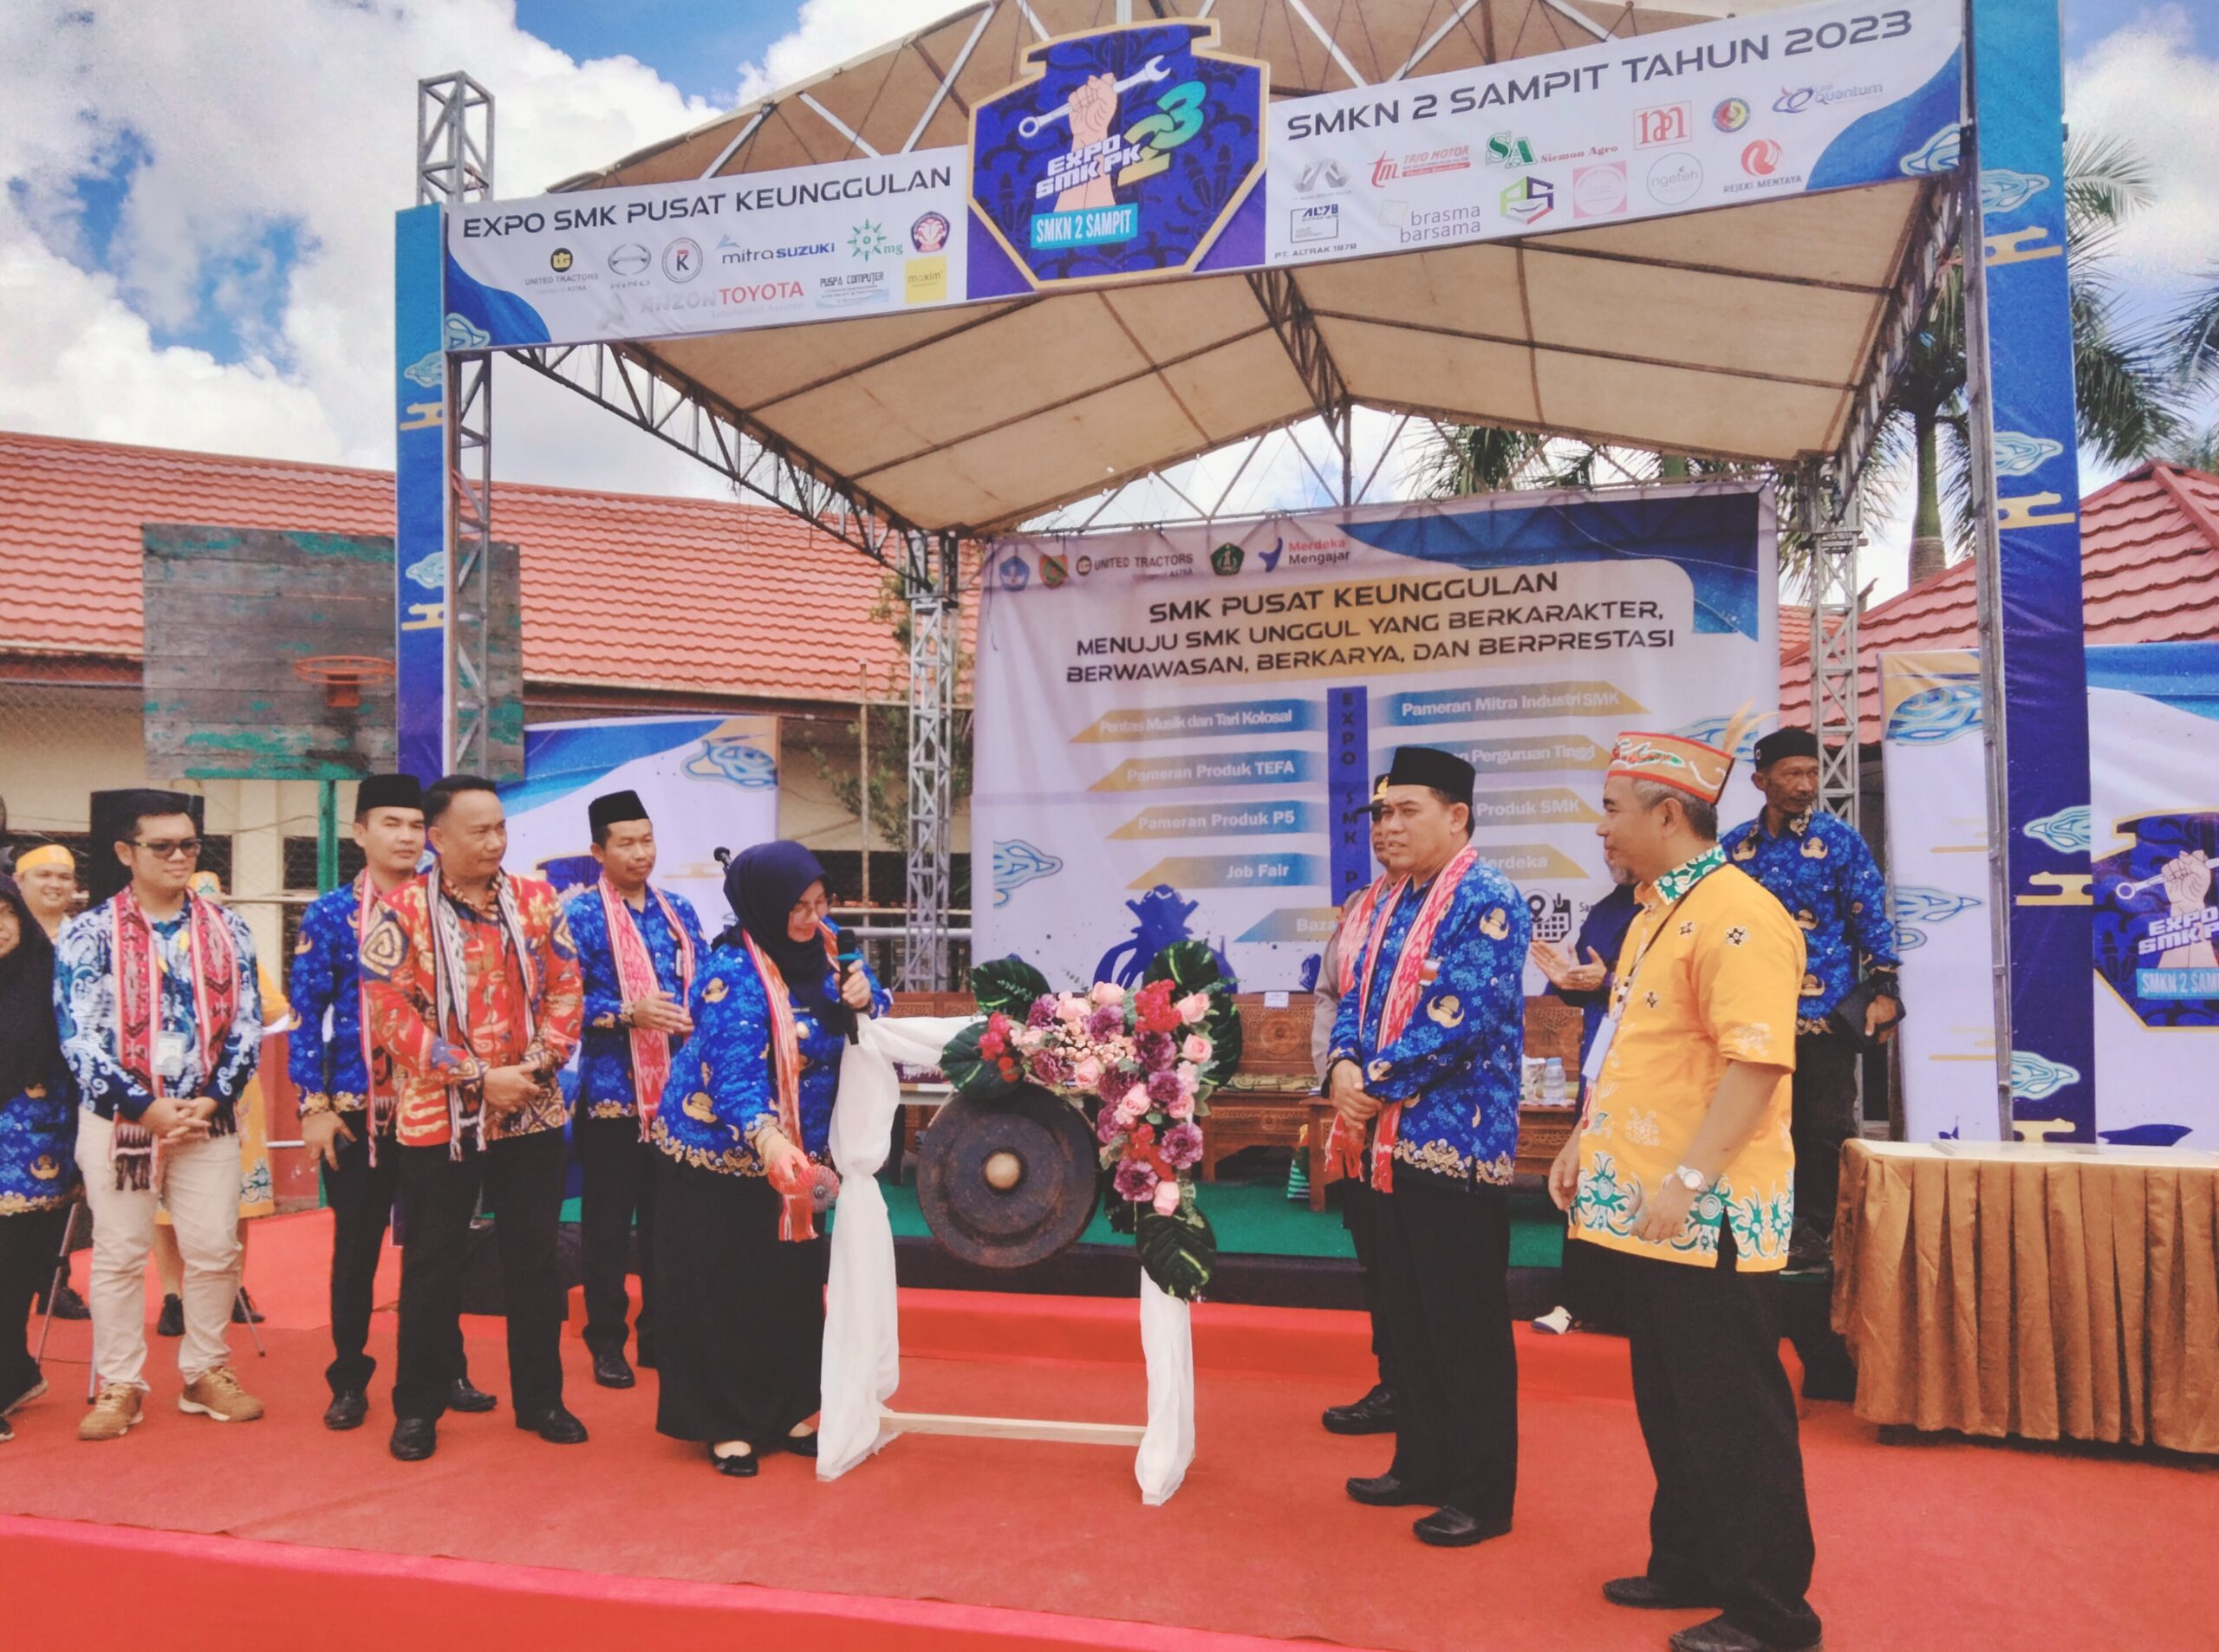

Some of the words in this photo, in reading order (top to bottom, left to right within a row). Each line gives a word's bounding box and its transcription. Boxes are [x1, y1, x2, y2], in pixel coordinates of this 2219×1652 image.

[1287, 100, 1400, 140] SMKN
[1412, 94, 1438, 120] 2
[1450, 62, 1610, 114] SAMPIT
[1621, 34, 1769, 83] TAHUN
[1784, 10, 1912, 56] 2023
[1815, 84, 1884, 105] Quantum
[1047, 133, 1121, 177] EXPO
[1403, 152, 1429, 164] TRIO
[1431, 145, 1470, 160] MOTOR
[1589, 146, 1618, 156] Agro
[1035, 160, 1100, 199] SMK
[1103, 143, 1142, 174] PK
[1723, 182, 1754, 194] REJEKI
[1756, 174, 1803, 189] MENTAYA
[463, 212, 545, 237] EXPO
[554, 205, 617, 231] SMK
[627, 193, 726, 224] PUSAT
[736, 166, 951, 212] KEUNGGULAN
[1036, 214, 1071, 244] SMKN
[1075, 214, 1083, 239] 2
[1085, 209, 1132, 237] SAMPIT
[1410, 205, 1480, 227] brasma
[1400, 220, 1480, 244] barsama
[1292, 245, 1331, 257] ALTRAK
[1333, 242, 1357, 251] 1978
[524, 276, 553, 287] UNITED
[556, 273, 599, 283] TRACTORS
[609, 280, 651, 290] HINO
[819, 276, 843, 288] PUSPA
[846, 271, 884, 285] COMPUTER
[1288, 538, 1347, 552] Merdeka
[1094, 556, 1130, 570] UNITED
[1134, 553, 1194, 569] TRACTORS
[1288, 550, 1351, 565] Mengajar
[1169, 568, 1194, 577] ASTRA
[1149, 598, 1212, 623] SMK
[1221, 589, 1324, 617] PUSAT
[1334, 570, 1558, 608] KEUNGGULAN
[1077, 633, 1179, 656] MENUJU
[1185, 628, 1241, 648] SMK
[1248, 619, 1361, 643] UNGGUL
[1368, 613, 1441, 635] YANG
[1448, 601, 1664, 629] BERKARAKTER,
[1066, 654, 1250, 683] BERWAWASAN,
[1256, 647, 1405, 672] BERKARYA,
[1413, 639, 1470, 662] DAN
[1478, 628, 1675, 656] BERPRESTASI
[1402, 702, 1472, 718] Pameran
[1475, 696, 1518, 711] Mitra
[1521, 693, 1581, 709] Industri
[1583, 693, 1619, 706] SMK
[1146, 715, 1186, 731] Musik
[1188, 713, 1214, 728] dan
[1214, 712, 1240, 727] Tari
[1241, 709, 1293, 725] Kolosal
[1340, 692, 1357, 766] EXPO
[1472, 747, 1552, 764] Perguruan
[1552, 744, 1597, 761] Tinggi
[1127, 767, 1192, 782] Pameran
[1195, 763, 1252, 778] Produk
[1254, 759, 1295, 776] TEFA
[1476, 801, 1537, 817] Produk
[1539, 798, 1580, 814] SMK
[1138, 816, 1207, 830] Pameran
[1211, 810, 1269, 827] Produk
[1272, 810, 1296, 824] P5
[1226, 865, 1253, 879] Job
[1258, 862, 1290, 877] Fair
[2149, 906, 2219, 937] EXPO
[2138, 926, 2201, 955] SMK
[2142, 972, 2177, 994] SMKN
[2180, 972, 2189, 993] 2
[2190, 972, 2219, 993] SAM
